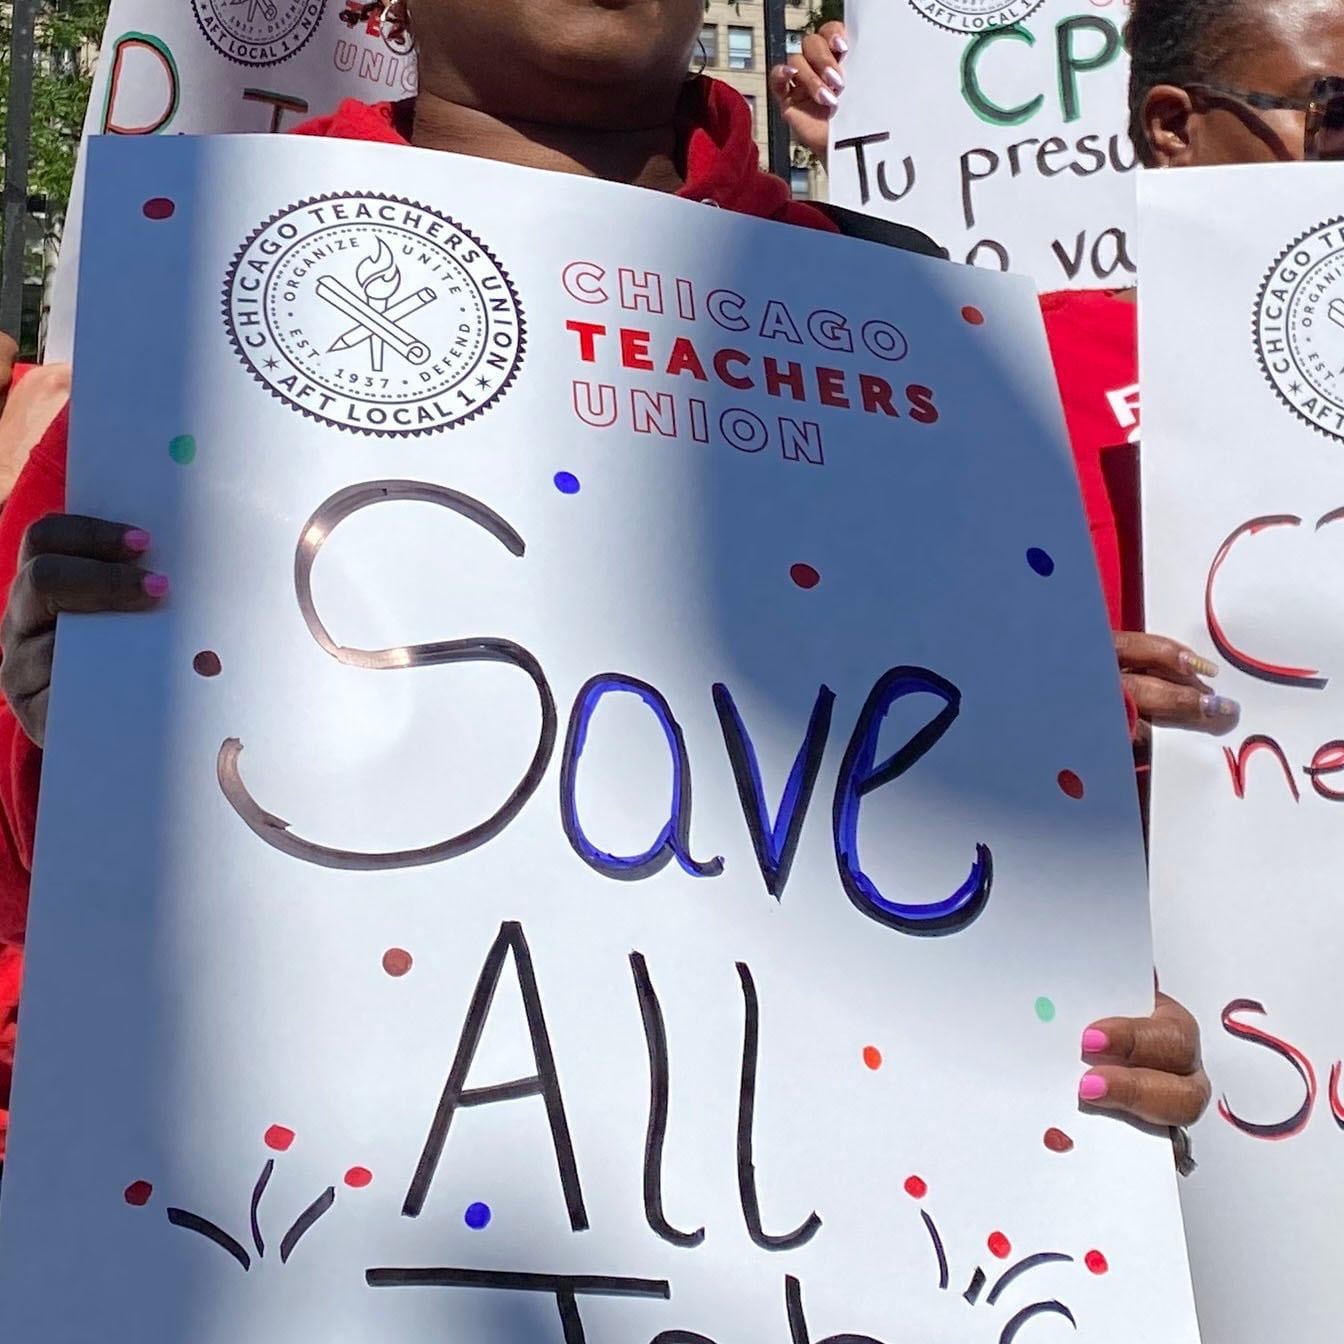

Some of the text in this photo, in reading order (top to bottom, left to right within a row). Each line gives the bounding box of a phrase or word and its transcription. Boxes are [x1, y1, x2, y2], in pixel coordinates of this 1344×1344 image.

[204, 16, 226, 42] AFT
[229, 40, 277, 59] LOCAL
[925, 3, 956, 24] AFT
[962, 9, 1019, 28] LOCAL
[959, 14, 1130, 126] CP
[834, 131, 916, 206] Tu
[237, 203, 513, 371] CHICAGO TEACHERS UNION
[562, 261, 908, 361] CHICAGO
[1265, 250, 1311, 374] CHICAGO
[277, 374, 476, 426] AFT LOCAL 1
[565, 319, 940, 425] TEACHERS
[572, 380, 825, 465] UNION
[215, 478, 993, 938] Save
[401, 920, 823, 1252] All
